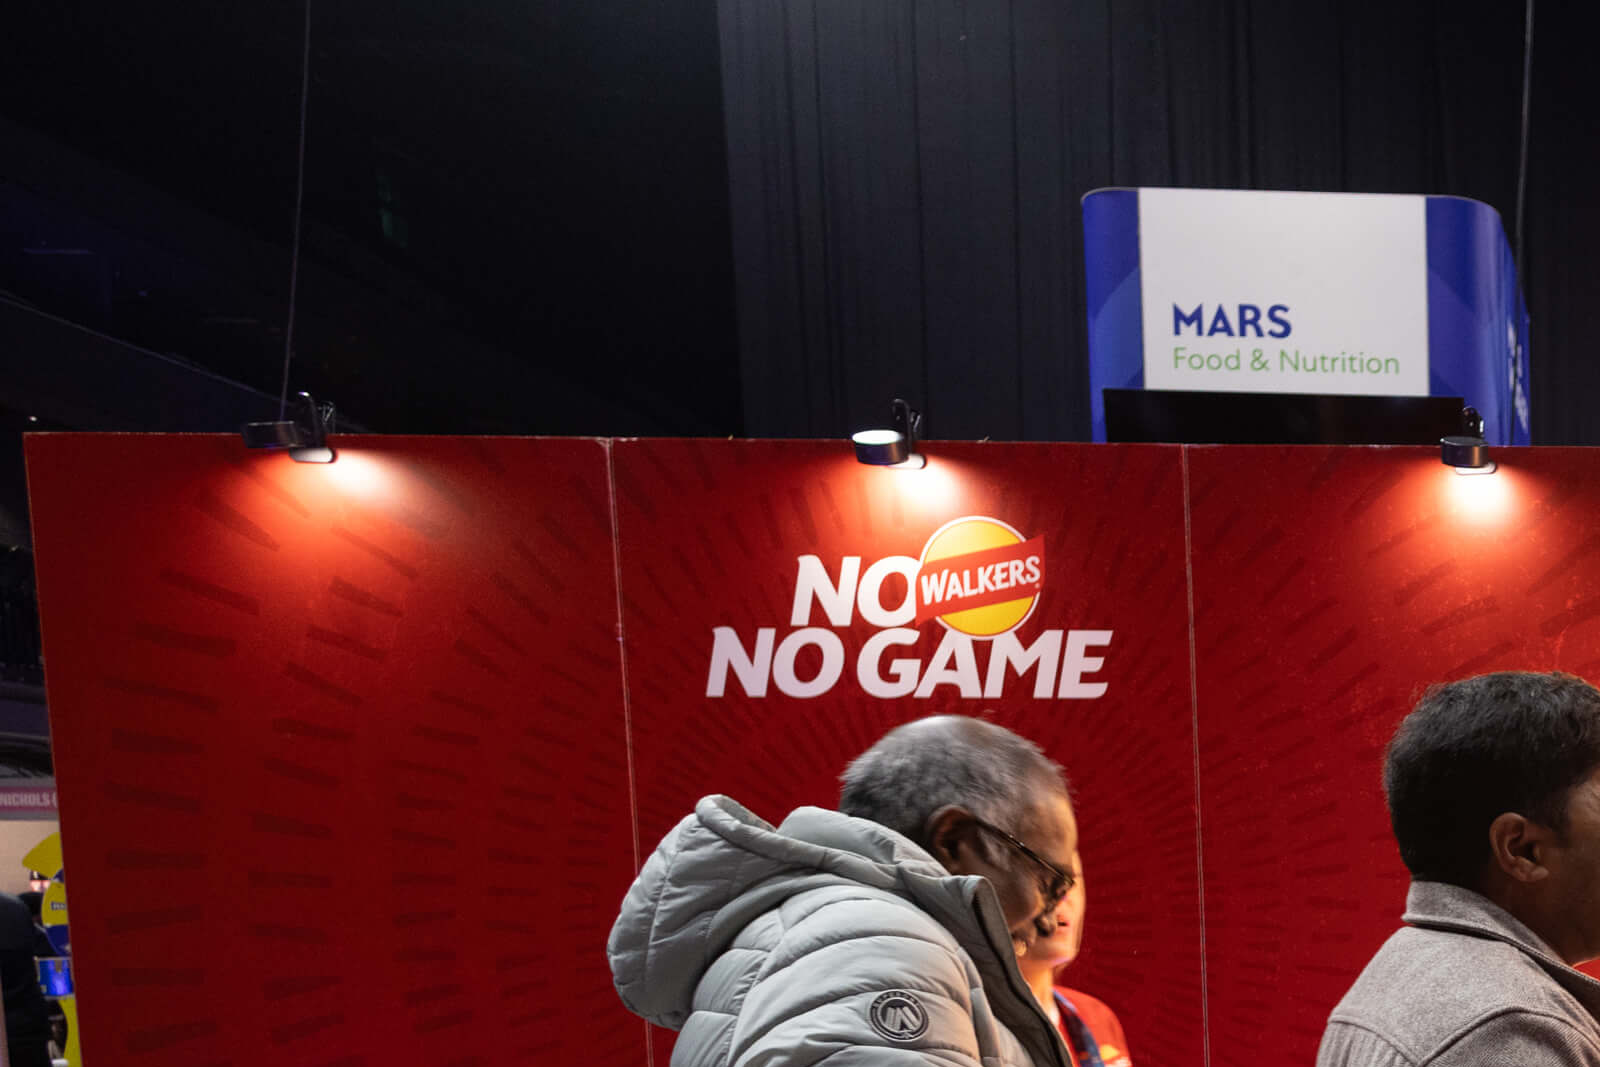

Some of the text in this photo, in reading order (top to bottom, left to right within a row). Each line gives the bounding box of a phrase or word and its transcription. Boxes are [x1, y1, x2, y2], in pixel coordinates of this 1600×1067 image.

[1172, 303, 1293, 339] MARS
[1173, 347, 1400, 375] Food & Nutrition
[791, 555, 1041, 627] NO WALKERS
[706, 627, 1113, 699] NO GAME
